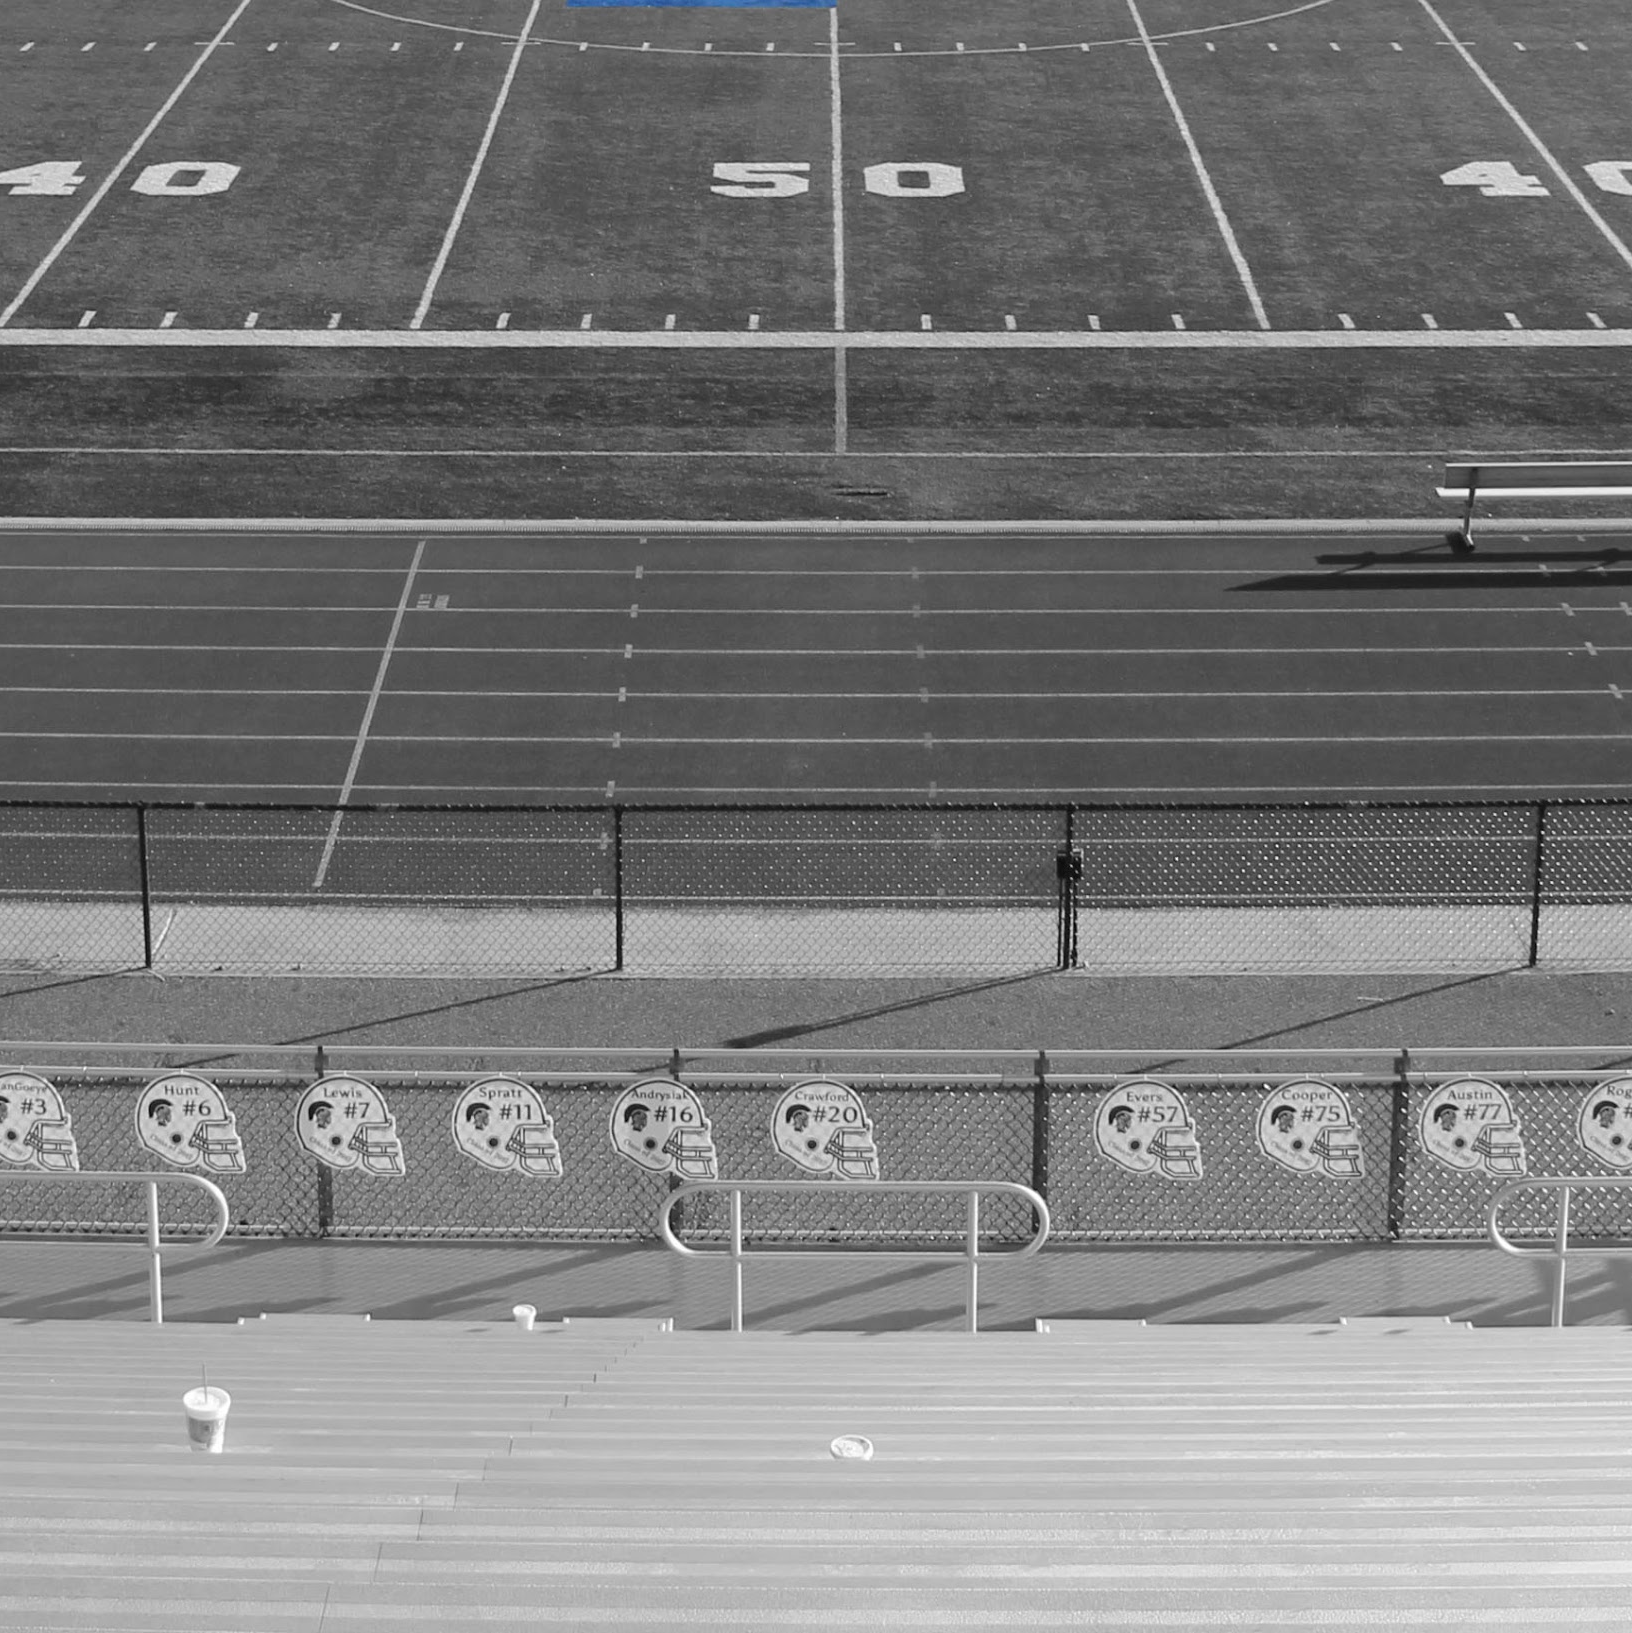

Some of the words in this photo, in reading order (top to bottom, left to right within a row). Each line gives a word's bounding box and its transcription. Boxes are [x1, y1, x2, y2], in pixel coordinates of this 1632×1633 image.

[710, 161, 967, 198] 50
[164, 1085, 200, 1096] Hunt
[323, 1087, 362, 1098] Lewis
[479, 1086, 522, 1100] Spratt
[795, 1091, 849, 1102] Crawford
[1126, 1091, 1163, 1102] Evers
[1281, 1089, 1333, 1103] Cooper
[1447, 1090, 1493, 1100] Austin
[20, 1098, 47, 1115] #3
[183, 1099, 211, 1116] #6
[344, 1102, 370, 1119] #7
[500, 1103, 532, 1120] #11
[654, 1105, 693, 1123] #16
[813, 1105, 858, 1123] #20
[1138, 1106, 1178, 1123] #57
[1300, 1105, 1341, 1122] #75
[1464, 1103, 1502, 1120] #77
